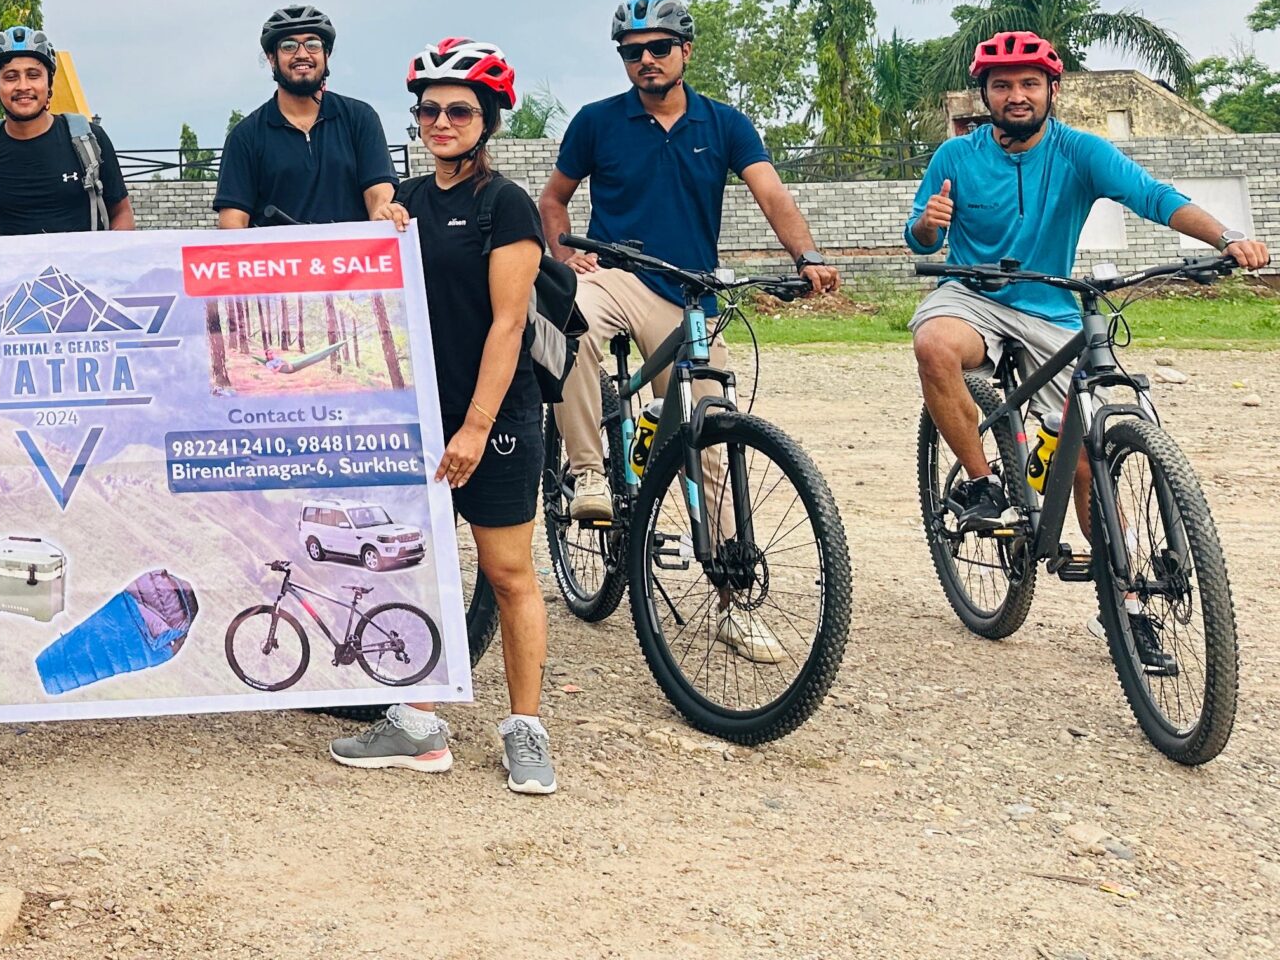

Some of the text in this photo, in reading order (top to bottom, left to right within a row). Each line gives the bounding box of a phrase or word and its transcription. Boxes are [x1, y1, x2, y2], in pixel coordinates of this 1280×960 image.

[190, 255, 392, 280] WE RENT & SALE
[3, 340, 109, 356] RENTAL & GEARS
[36, 411, 78, 427] 2024
[228, 406, 343, 425] Contact Us:
[172, 432, 409, 458] 9822412410, 9848120101
[172, 456, 418, 483] Birendranagar-6, Surkhet
